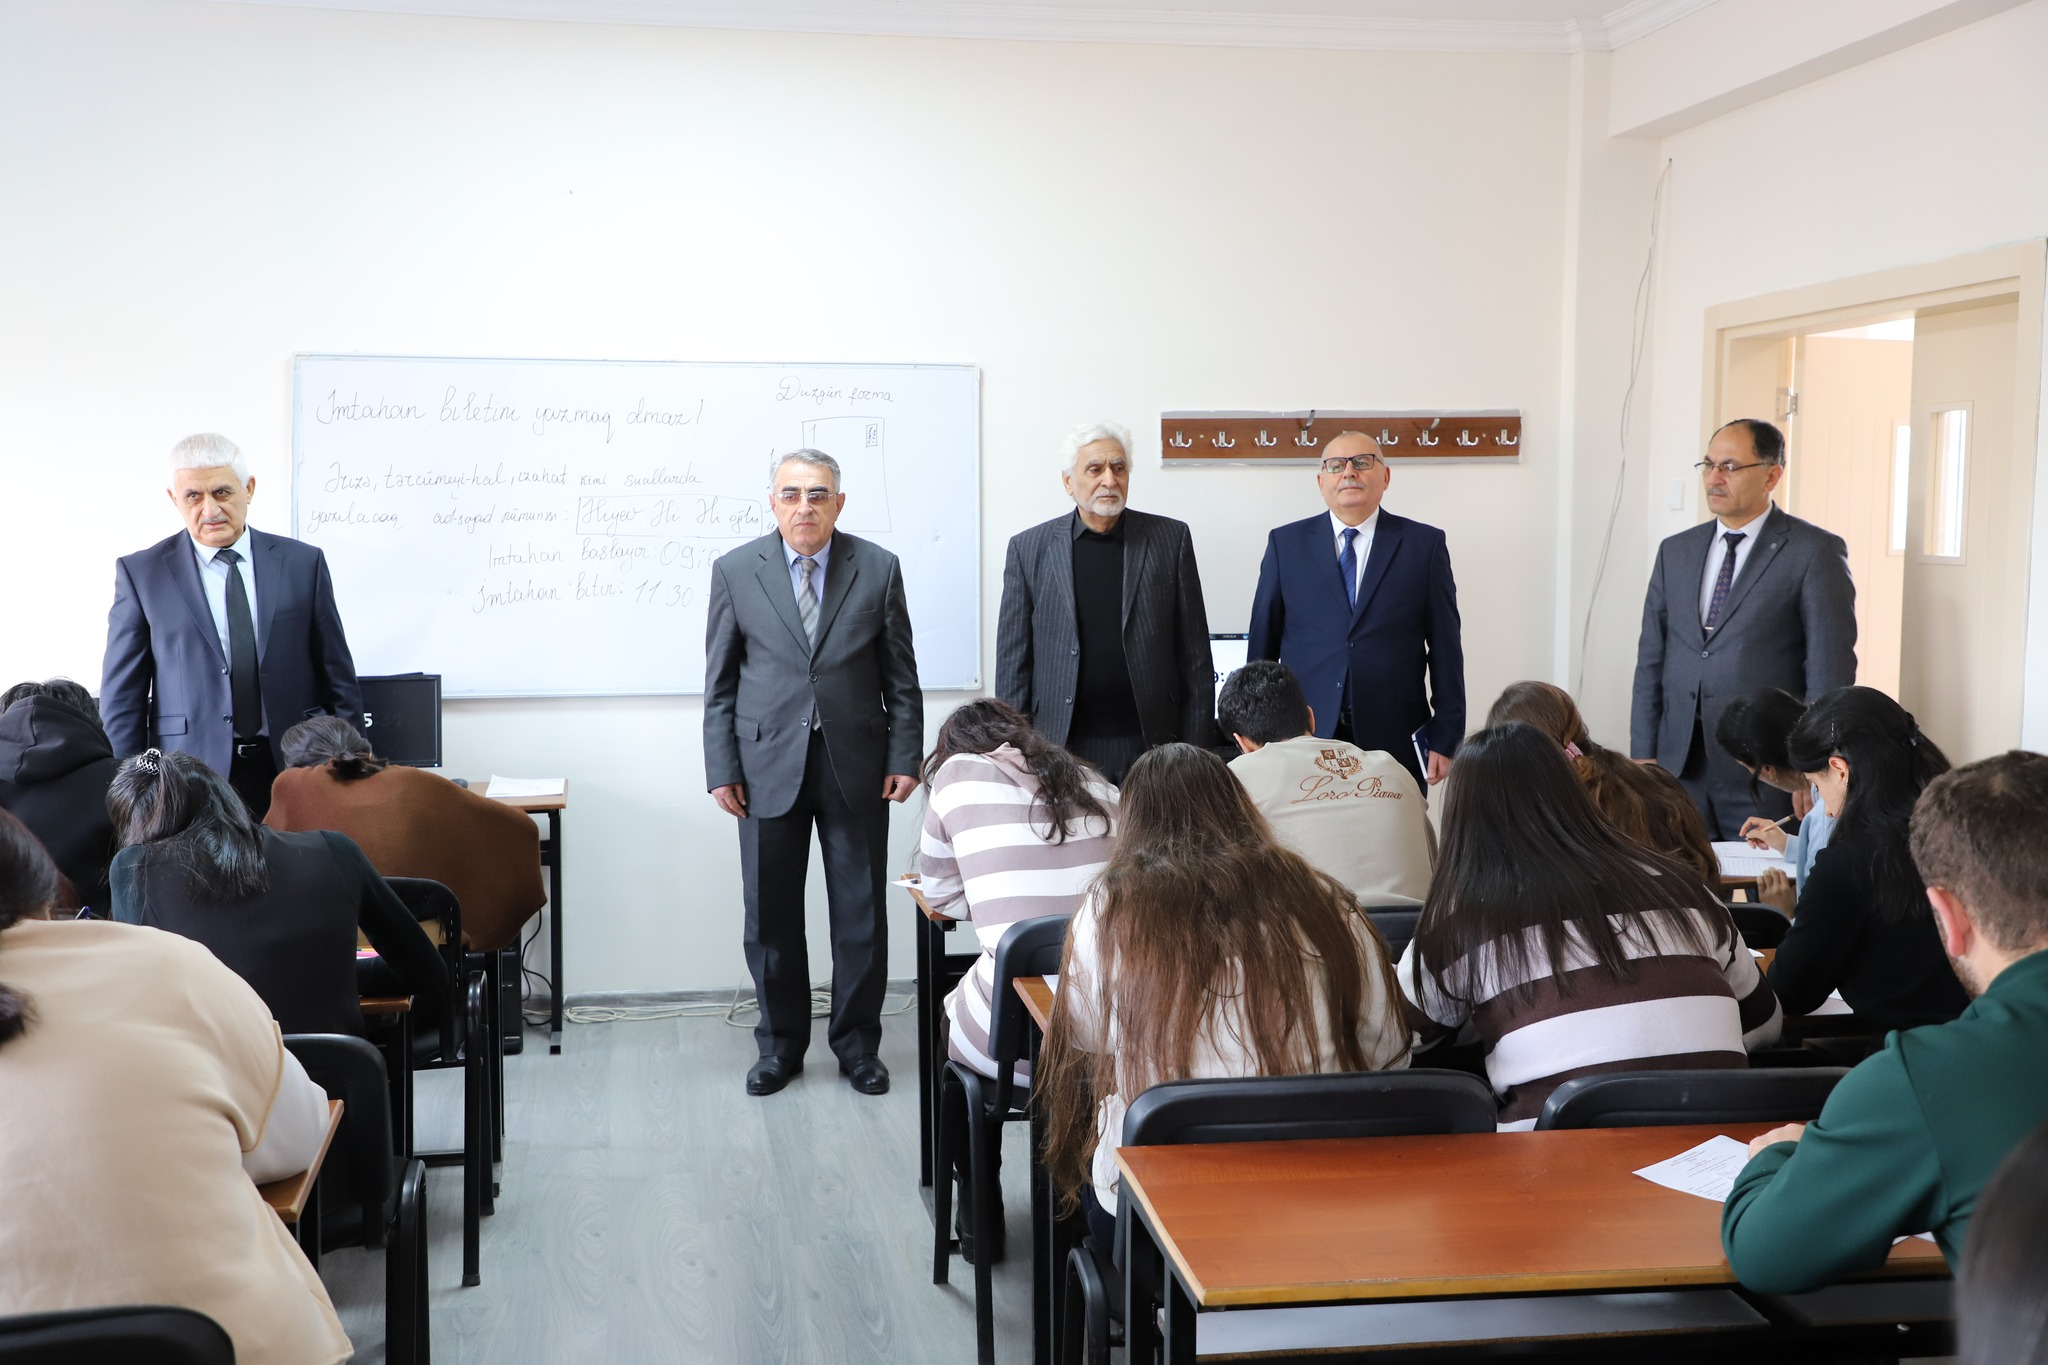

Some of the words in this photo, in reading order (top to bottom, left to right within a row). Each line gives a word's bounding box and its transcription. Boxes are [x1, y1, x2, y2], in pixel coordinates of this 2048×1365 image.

[532, 406, 616, 444] yazmaq
[580, 474, 609, 486] kimi
[624, 461, 704, 488] suallarda
[1291, 775, 1355, 804] Loro
[1354, 775, 1404, 800] Piana
